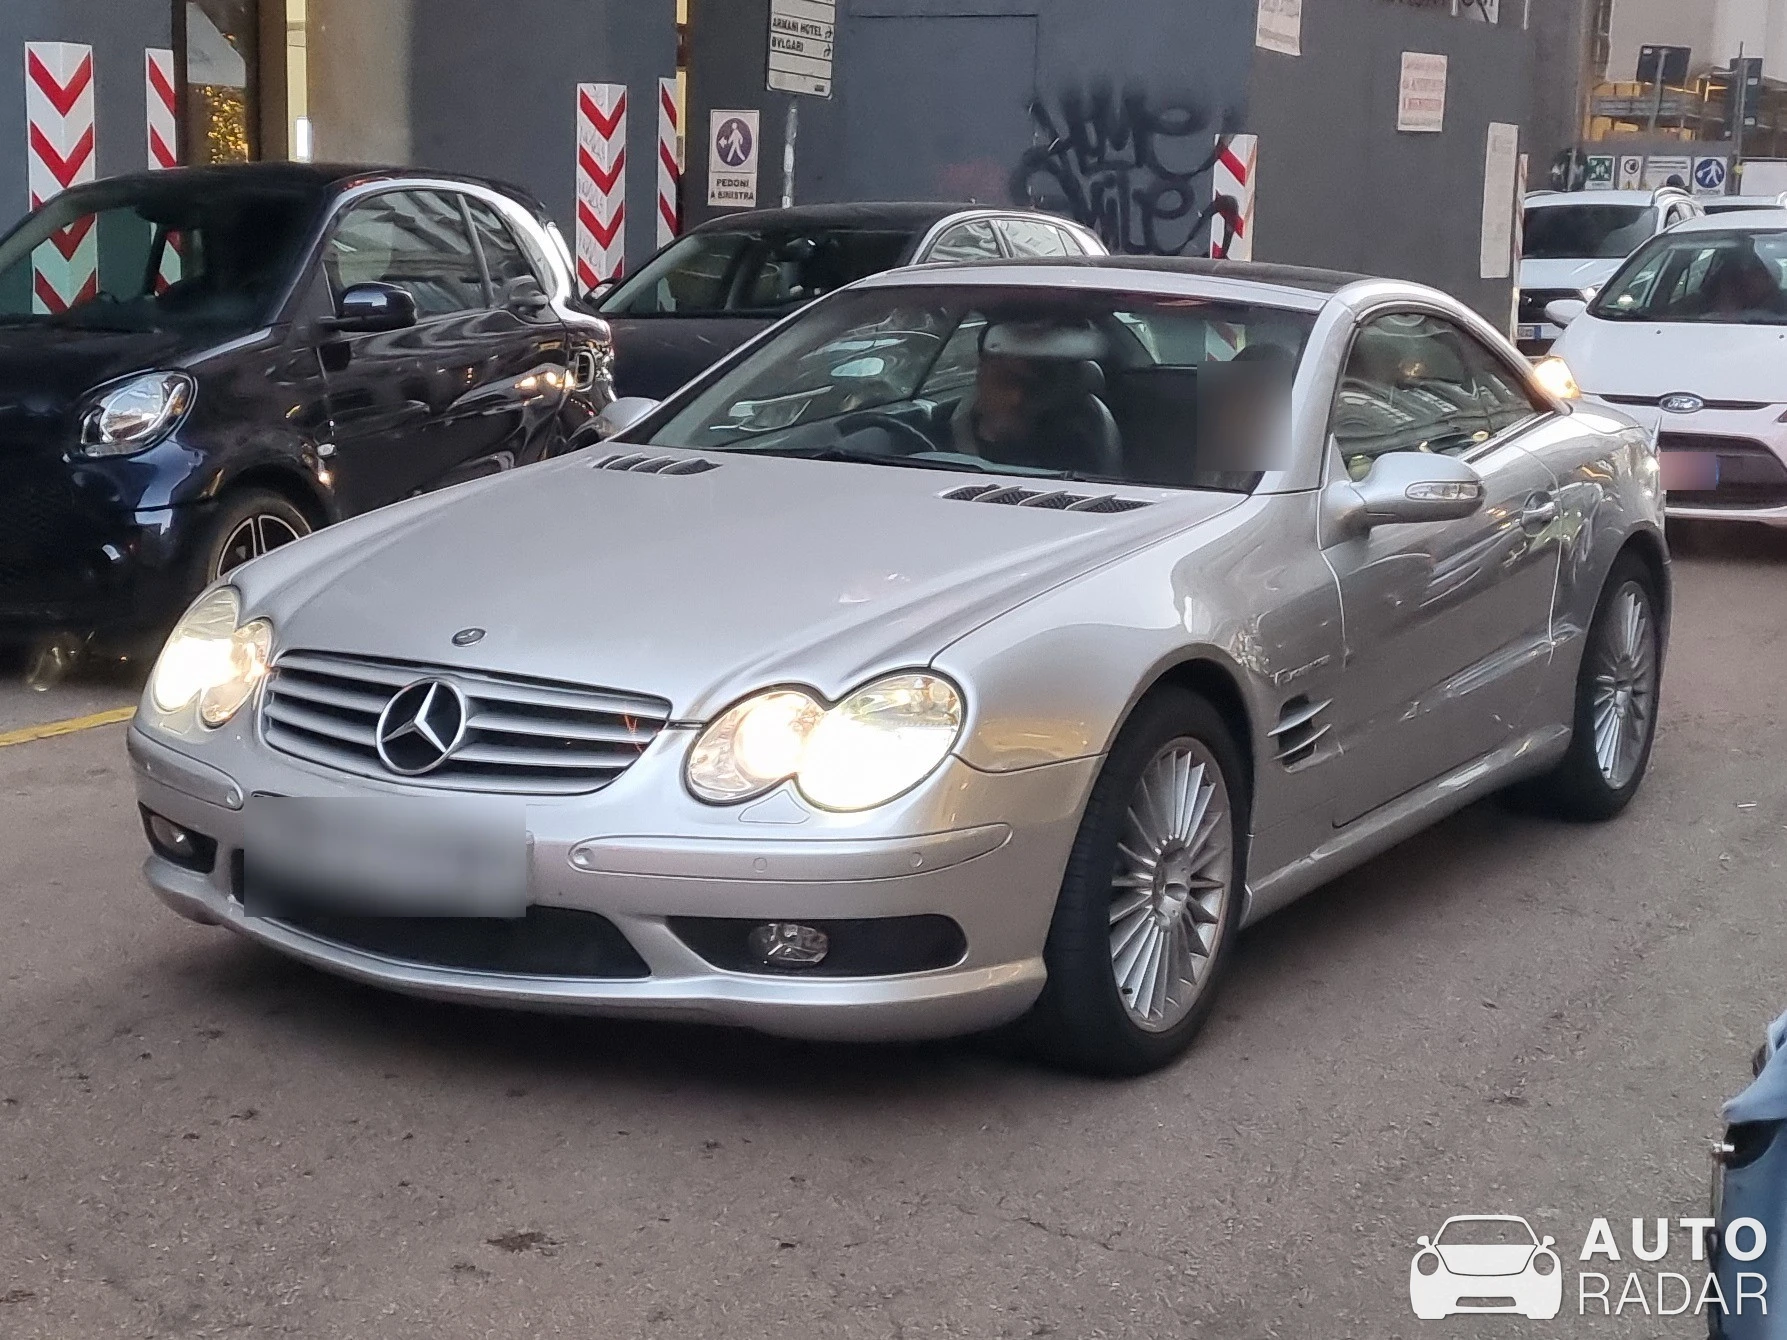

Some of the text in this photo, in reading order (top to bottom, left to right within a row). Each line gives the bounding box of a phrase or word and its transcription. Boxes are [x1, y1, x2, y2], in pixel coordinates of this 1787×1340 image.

[773, 17, 822, 37] ARMANI HOTEL
[716, 178, 750, 188] PEDONI
[710, 190, 754, 200] A SINISTRA
